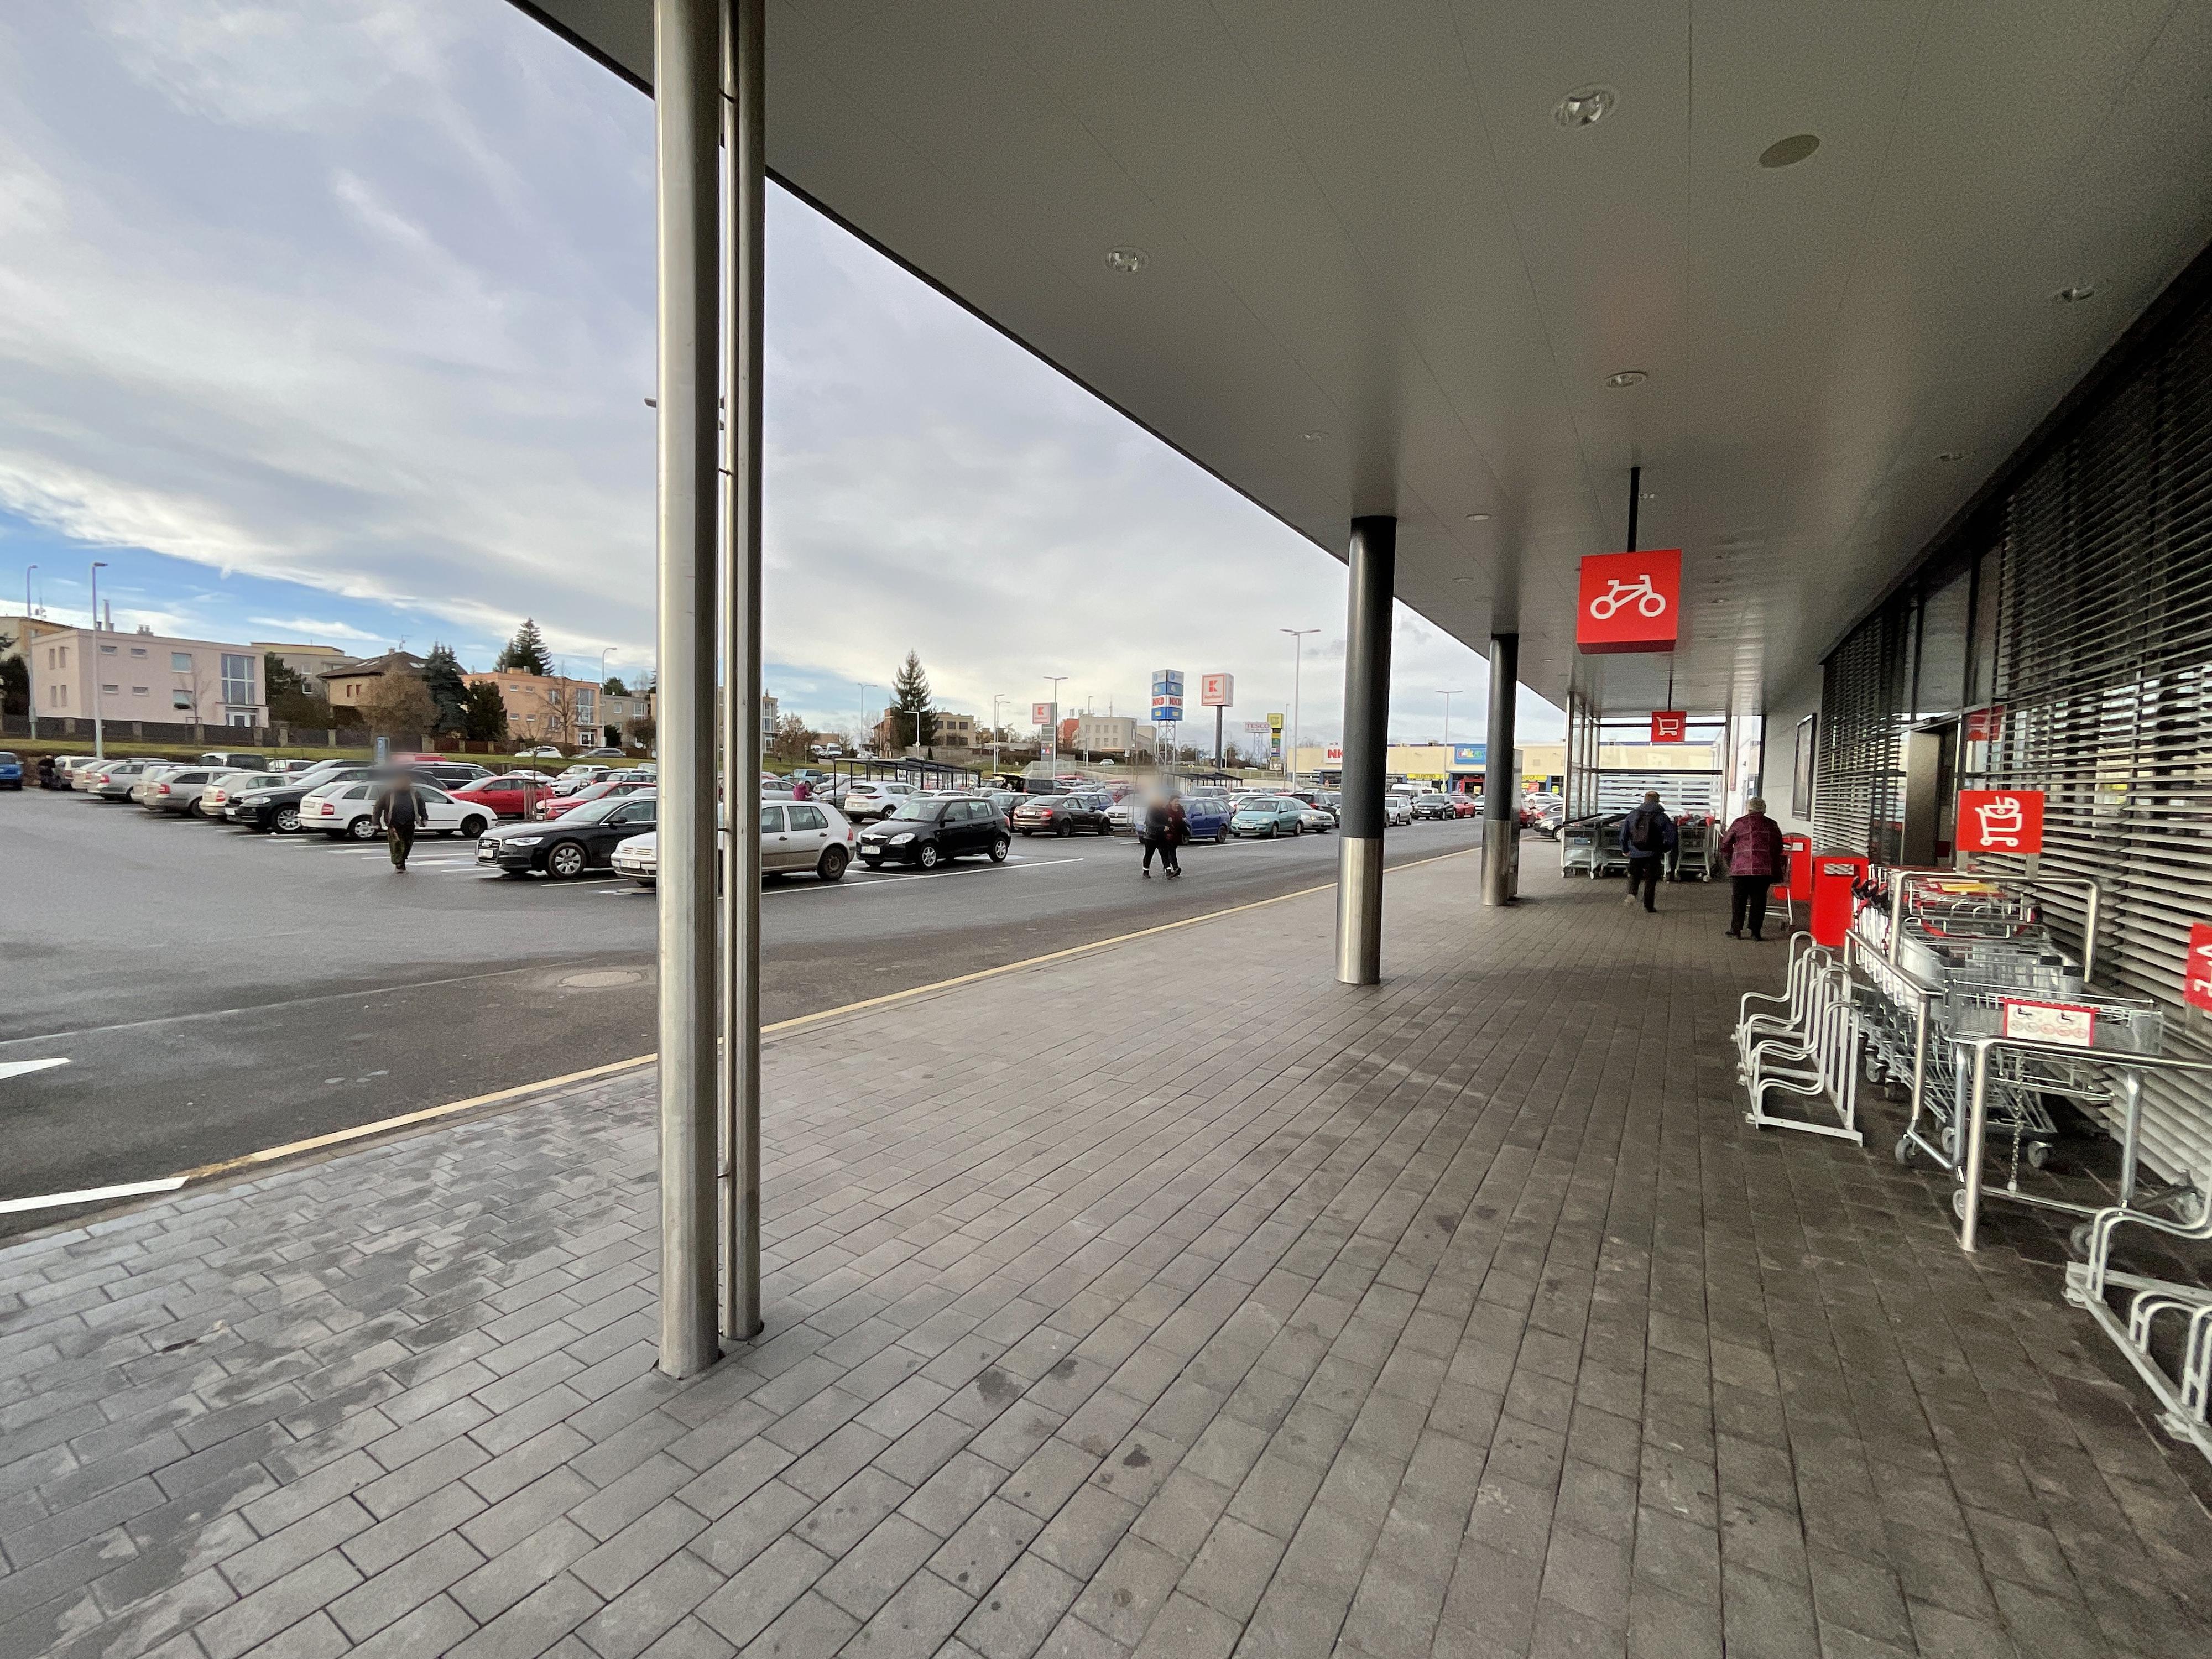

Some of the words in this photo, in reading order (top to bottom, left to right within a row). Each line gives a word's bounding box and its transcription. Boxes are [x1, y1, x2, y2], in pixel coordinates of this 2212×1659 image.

[1209, 680, 1218, 692] K
[1037, 707, 1045, 715] K
[1328, 749, 1343, 758] NK
